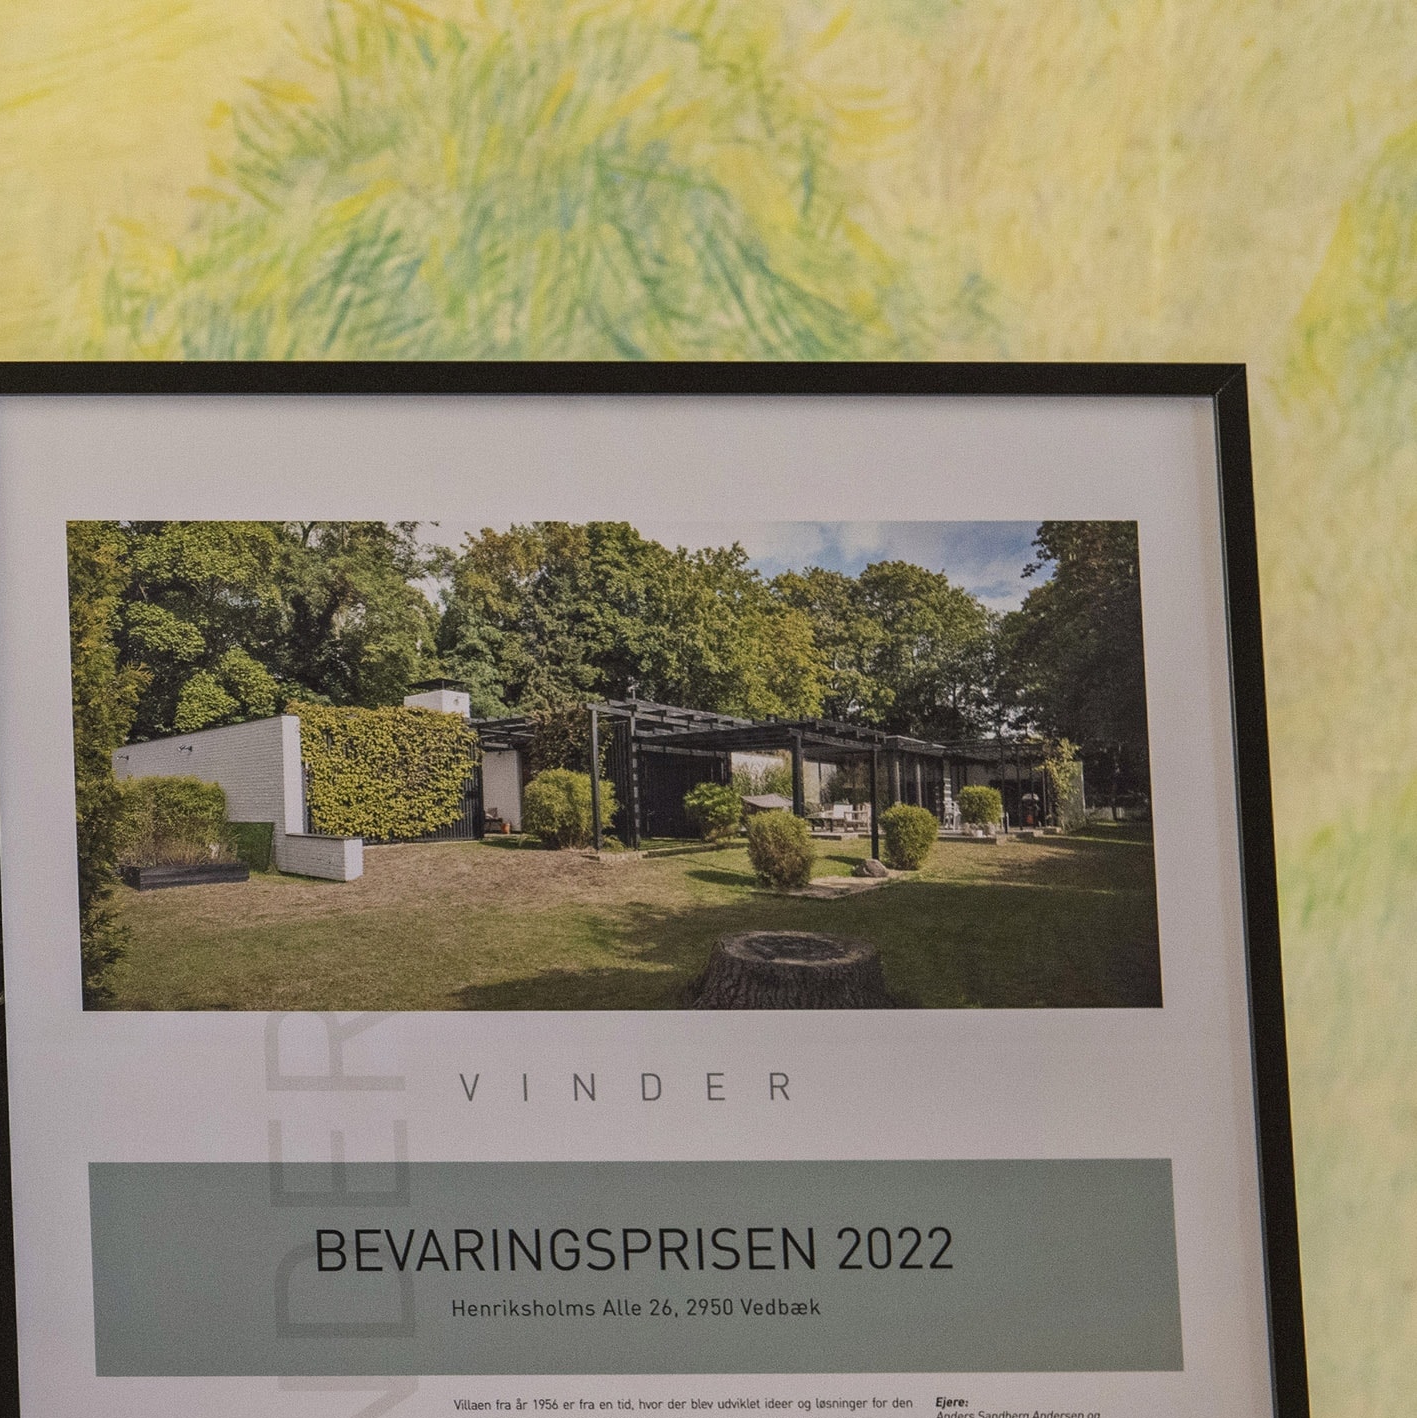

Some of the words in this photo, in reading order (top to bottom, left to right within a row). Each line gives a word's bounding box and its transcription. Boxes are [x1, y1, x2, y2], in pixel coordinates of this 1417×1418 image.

[459, 1072, 790, 1102] VINDER
[315, 1227, 816, 1272] BEVARINGSPRISEN
[836, 1226, 954, 1270] 2022
[451, 1299, 596, 1317] Henriksholms
[602, 1299, 642, 1317] Alle
[648, 1299, 679, 1318] 26,
[686, 1298, 734, 1316] 2950
[740, 1298, 821, 1316] Vedbæk
[453, 1398, 492, 1410] Villaen
[495, 1398, 511, 1410] fra
[515, 1397, 528, 1410] år
[533, 1398, 559, 1410] 1956
[562, 1401, 575, 1409] er
[579, 1398, 595, 1410] fra
[599, 1401, 613, 1410] en
[617, 1398, 634, 1410] tid,
[638, 1398, 663, 1409] hvor
[667, 1398, 687, 1409] der
[690, 1398, 713, 1409] blev
[717, 1397, 760, 1409] udviklet
[764, 1397, 793, 1409] ideer
[797, 1399, 811, 1412] og
[815, 1397, 868, 1412] løsninger
[872, 1396, 888, 1408] for
[891, 1396, 913, 1408] den
[935, 1396, 969, 1409] Ejere:
